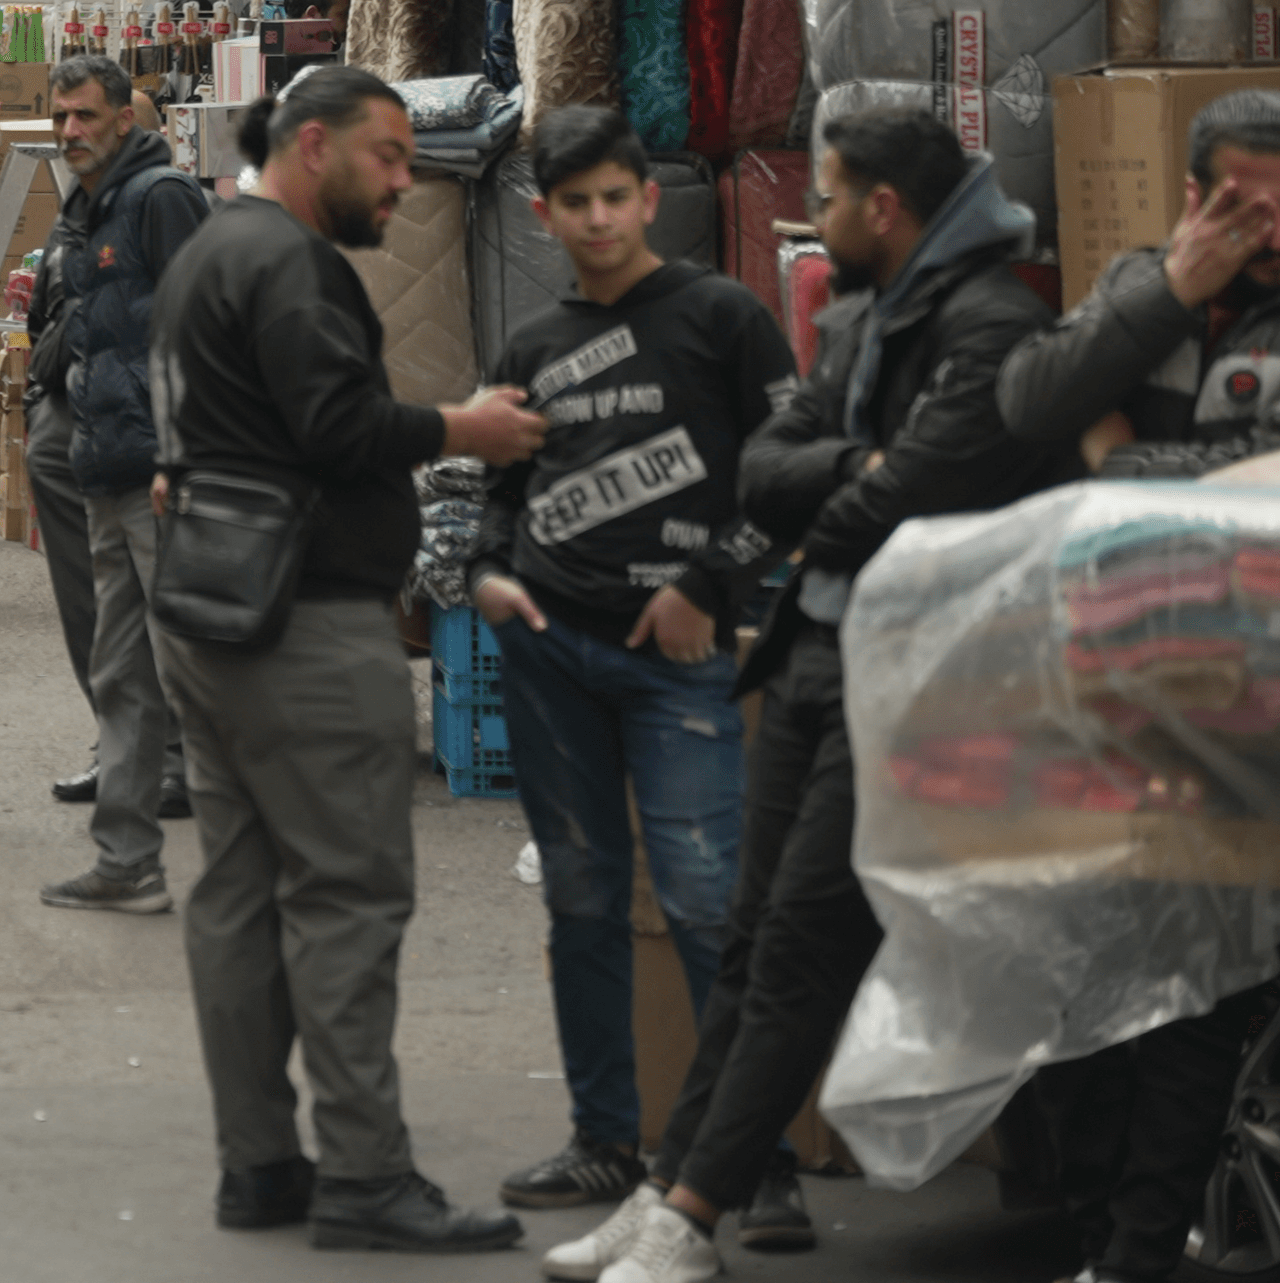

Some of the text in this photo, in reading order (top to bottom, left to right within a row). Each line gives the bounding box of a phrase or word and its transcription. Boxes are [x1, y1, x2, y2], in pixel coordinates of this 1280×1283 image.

[1255, 12, 1271, 58] PLUS
[959, 15, 981, 151] CRYSTAL PLU
[542, 486, 588, 538] EEP
[595, 469, 627, 507] IT
